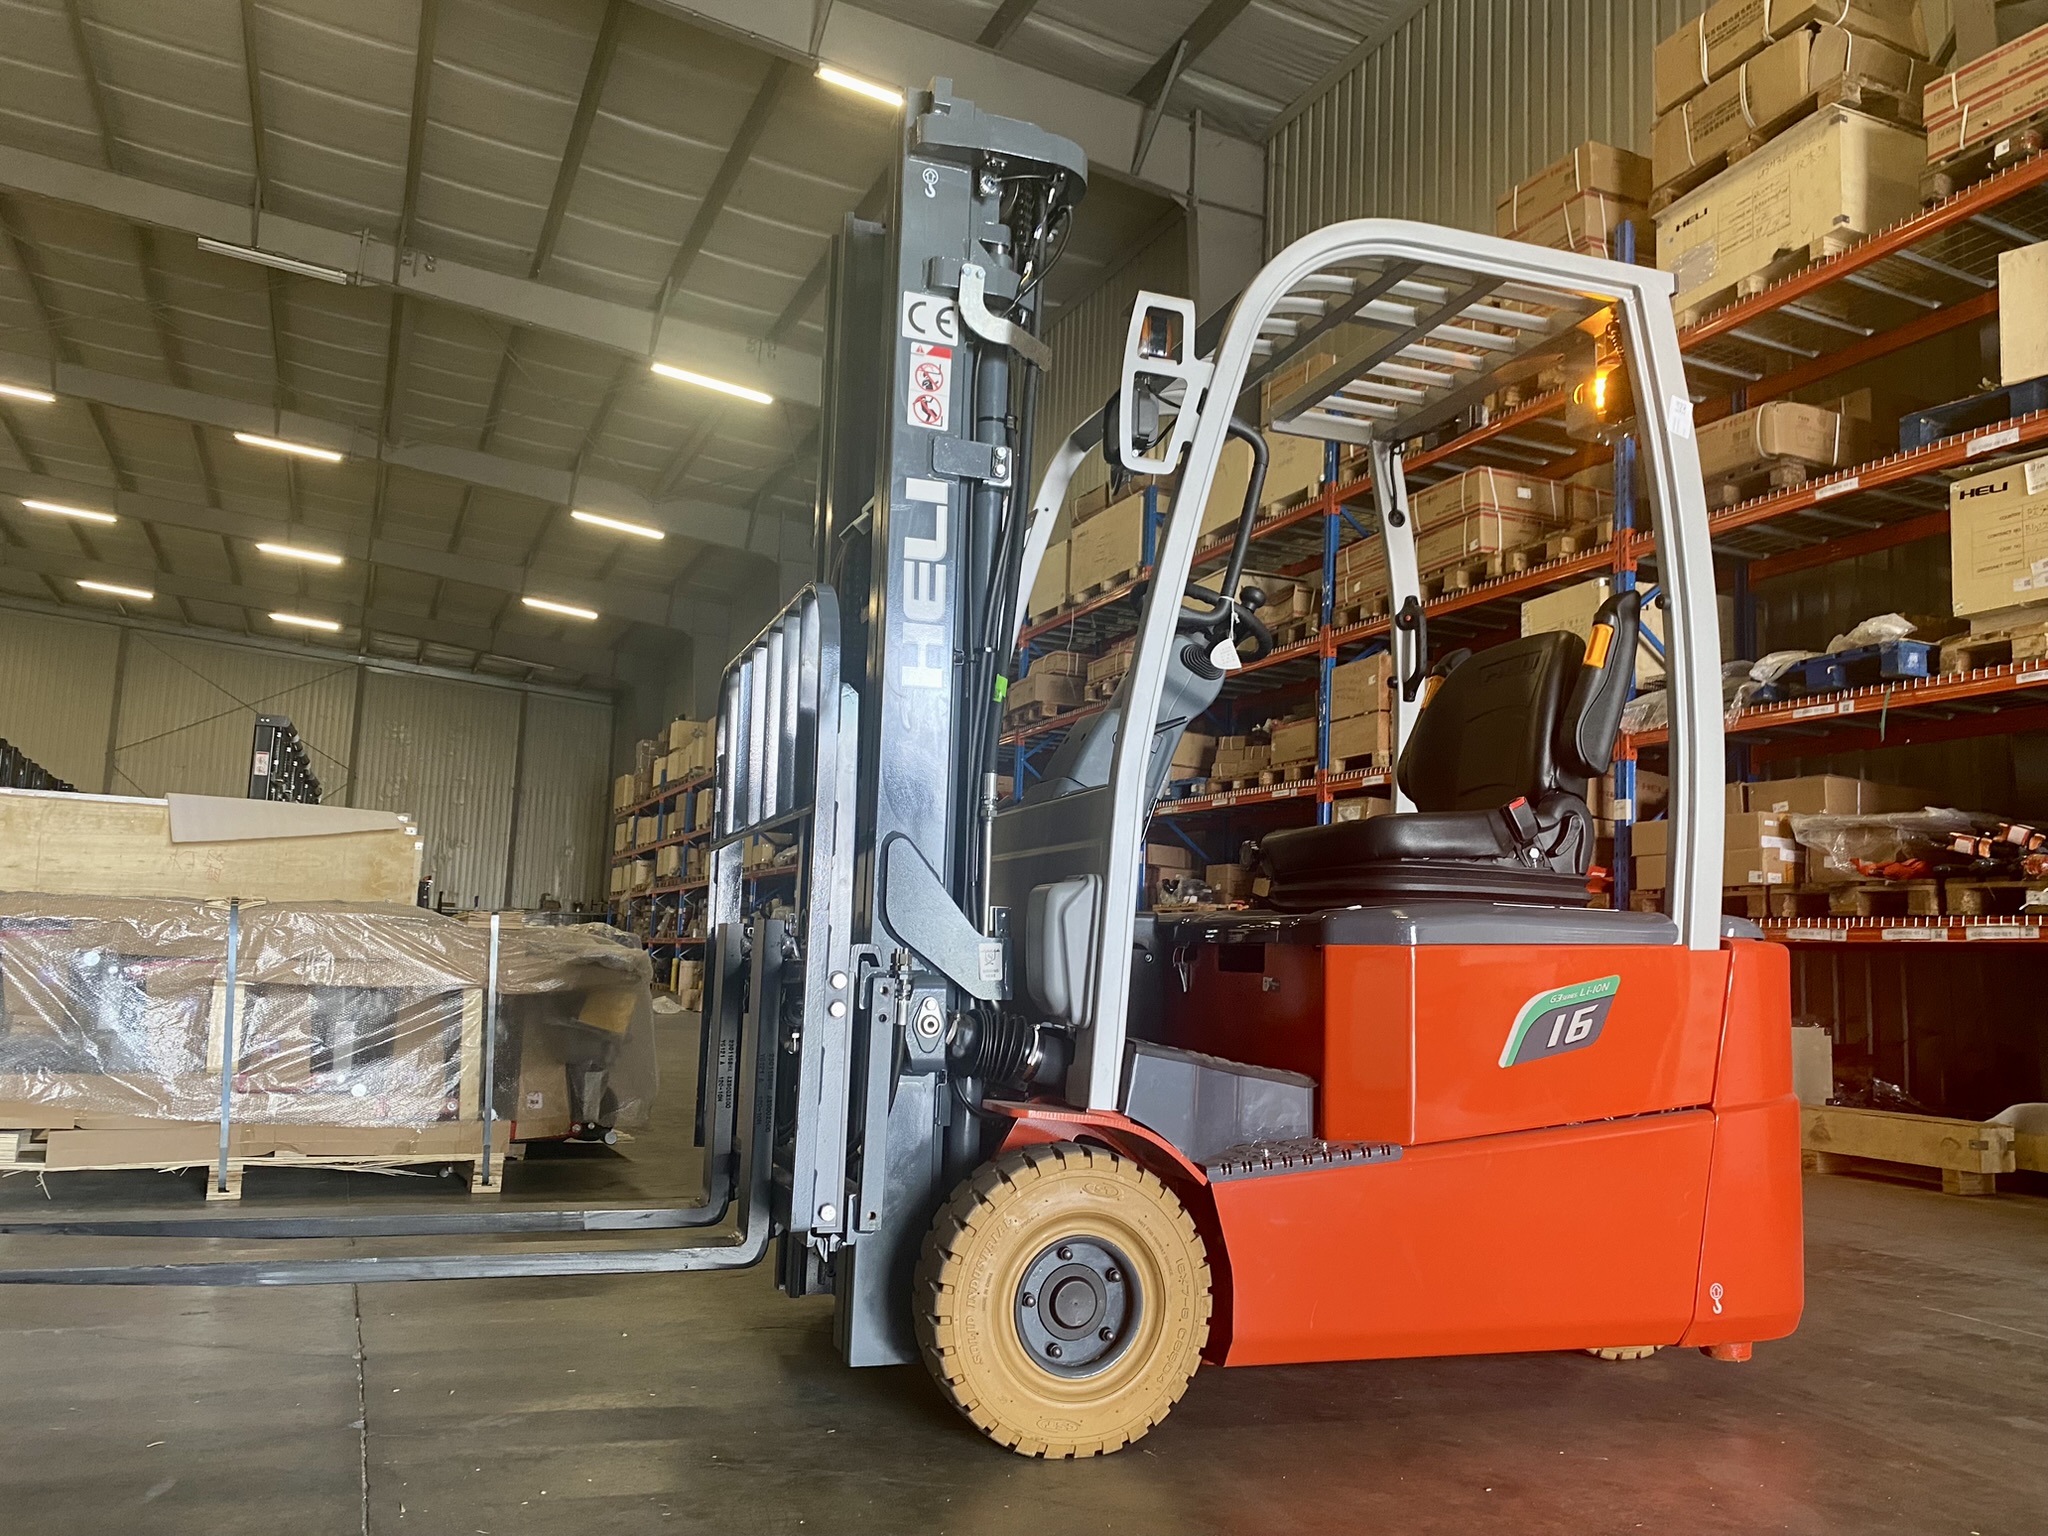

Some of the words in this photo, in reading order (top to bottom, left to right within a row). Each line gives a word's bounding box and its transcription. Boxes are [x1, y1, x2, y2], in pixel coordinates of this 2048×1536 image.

[1676, 208, 1708, 232] HELI
[907, 301, 954, 339] CE
[1959, 482, 2009, 500] HELI
[901, 478, 948, 689] HELI
[1547, 1004, 1599, 1048] 16
[965, 1218, 1013, 1311] INDUSTRIAL
[965, 1316, 983, 1365] SOLID
